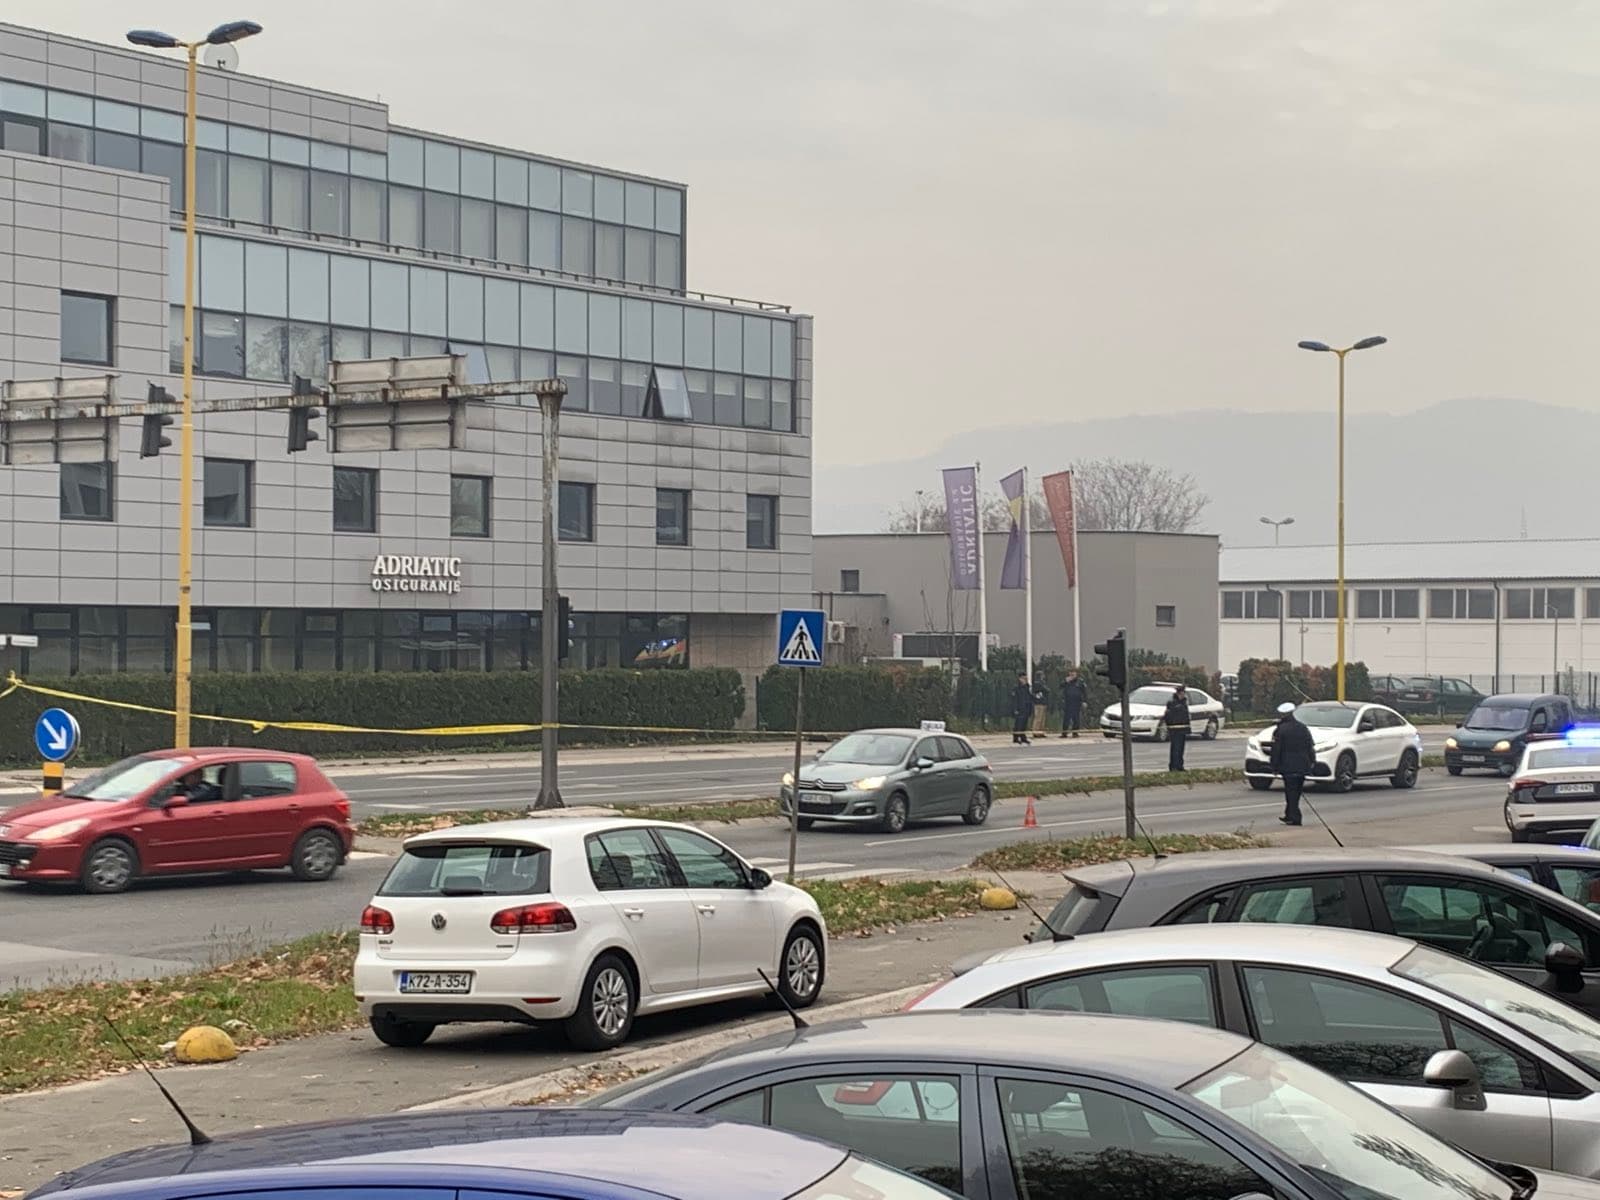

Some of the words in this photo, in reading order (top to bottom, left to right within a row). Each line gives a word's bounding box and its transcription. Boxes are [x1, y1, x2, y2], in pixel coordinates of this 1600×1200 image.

[372, 555, 461, 577] ADRIATIC
[372, 578, 461, 594] OSIGURANJE
[408, 974, 467, 988] K72-A-354
